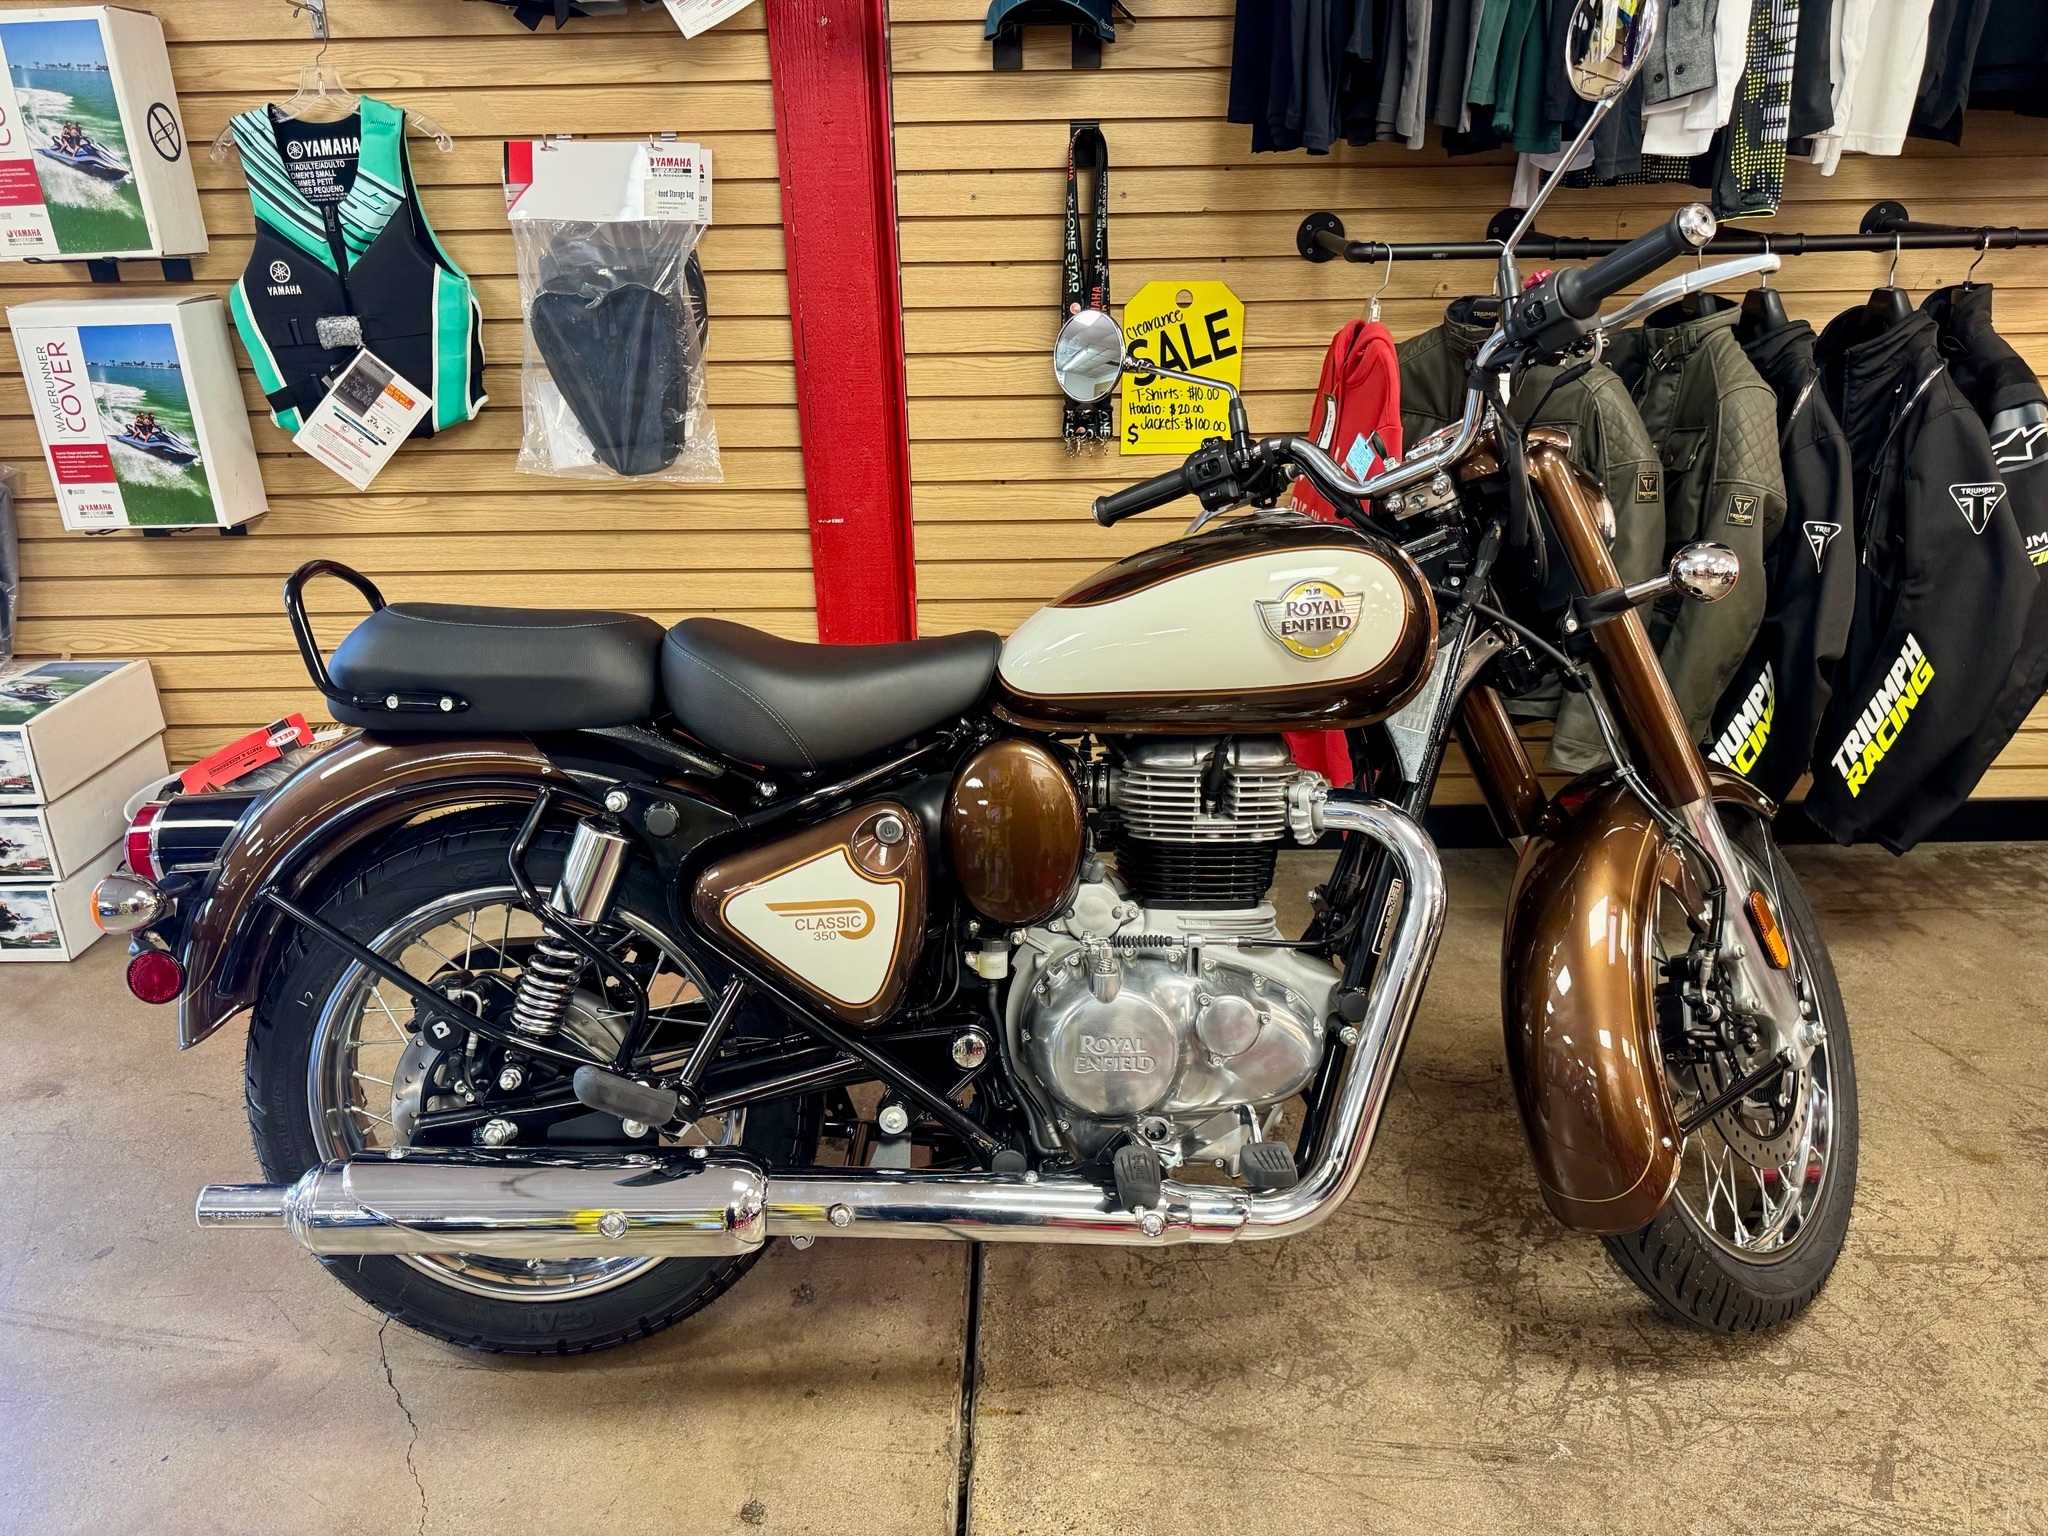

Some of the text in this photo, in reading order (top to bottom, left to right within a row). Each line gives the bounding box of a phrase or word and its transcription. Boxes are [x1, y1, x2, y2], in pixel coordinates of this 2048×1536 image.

[303, 136, 361, 157] YAMAHA
[286, 160, 345, 171] LT/ADULTE/ADULTO
[655, 157, 692, 167] YAMAHA
[290, 169, 337, 180] OMEN'S SMALL
[294, 177, 334, 187] EMMES PETIT
[669, 189, 685, 200] Storage
[686, 190, 694, 200] bag
[12, 228, 42, 238] YAMAHA
[1066, 208, 1080, 294] LONE STAR
[267, 285, 302, 296] YAMAHA
[1126, 309, 1184, 341] Clearance
[1126, 308, 1238, 387] SALE
[36, 346, 66, 433] WAVERUNNER
[47, 341, 87, 433] COVER
[1131, 385, 1220, 402] T-Shirts: $10.00
[1141, 416, 1227, 432] Jackets: $100.00
[1127, 423, 1139, 445] $
[1961, 486, 1996, 497] TRIUMPH
[84, 503, 113, 512] YAMAHA
[1814, 525, 1831, 534] TRIU
[1286, 598, 1345, 618] ROYAL
[1281, 615, 1352, 636] ENFIELD
[1707, 660, 1775, 767] IUMPH
[1831, 632, 1924, 779] TRIUMPH
[1728, 690, 1775, 777] CIN
[1845, 654, 1935, 798] RACING
[272, 729, 296, 744] BELL
[246, 745, 263, 756] PARTS
[208, 755, 241, 775] ACCESSORIES
[794, 915, 862, 931] CLASSIC
[813, 930, 837, 941] 350
[1079, 1034, 1147, 1055] ROYAL
[1073, 1055, 1156, 1074] ENFIELD
